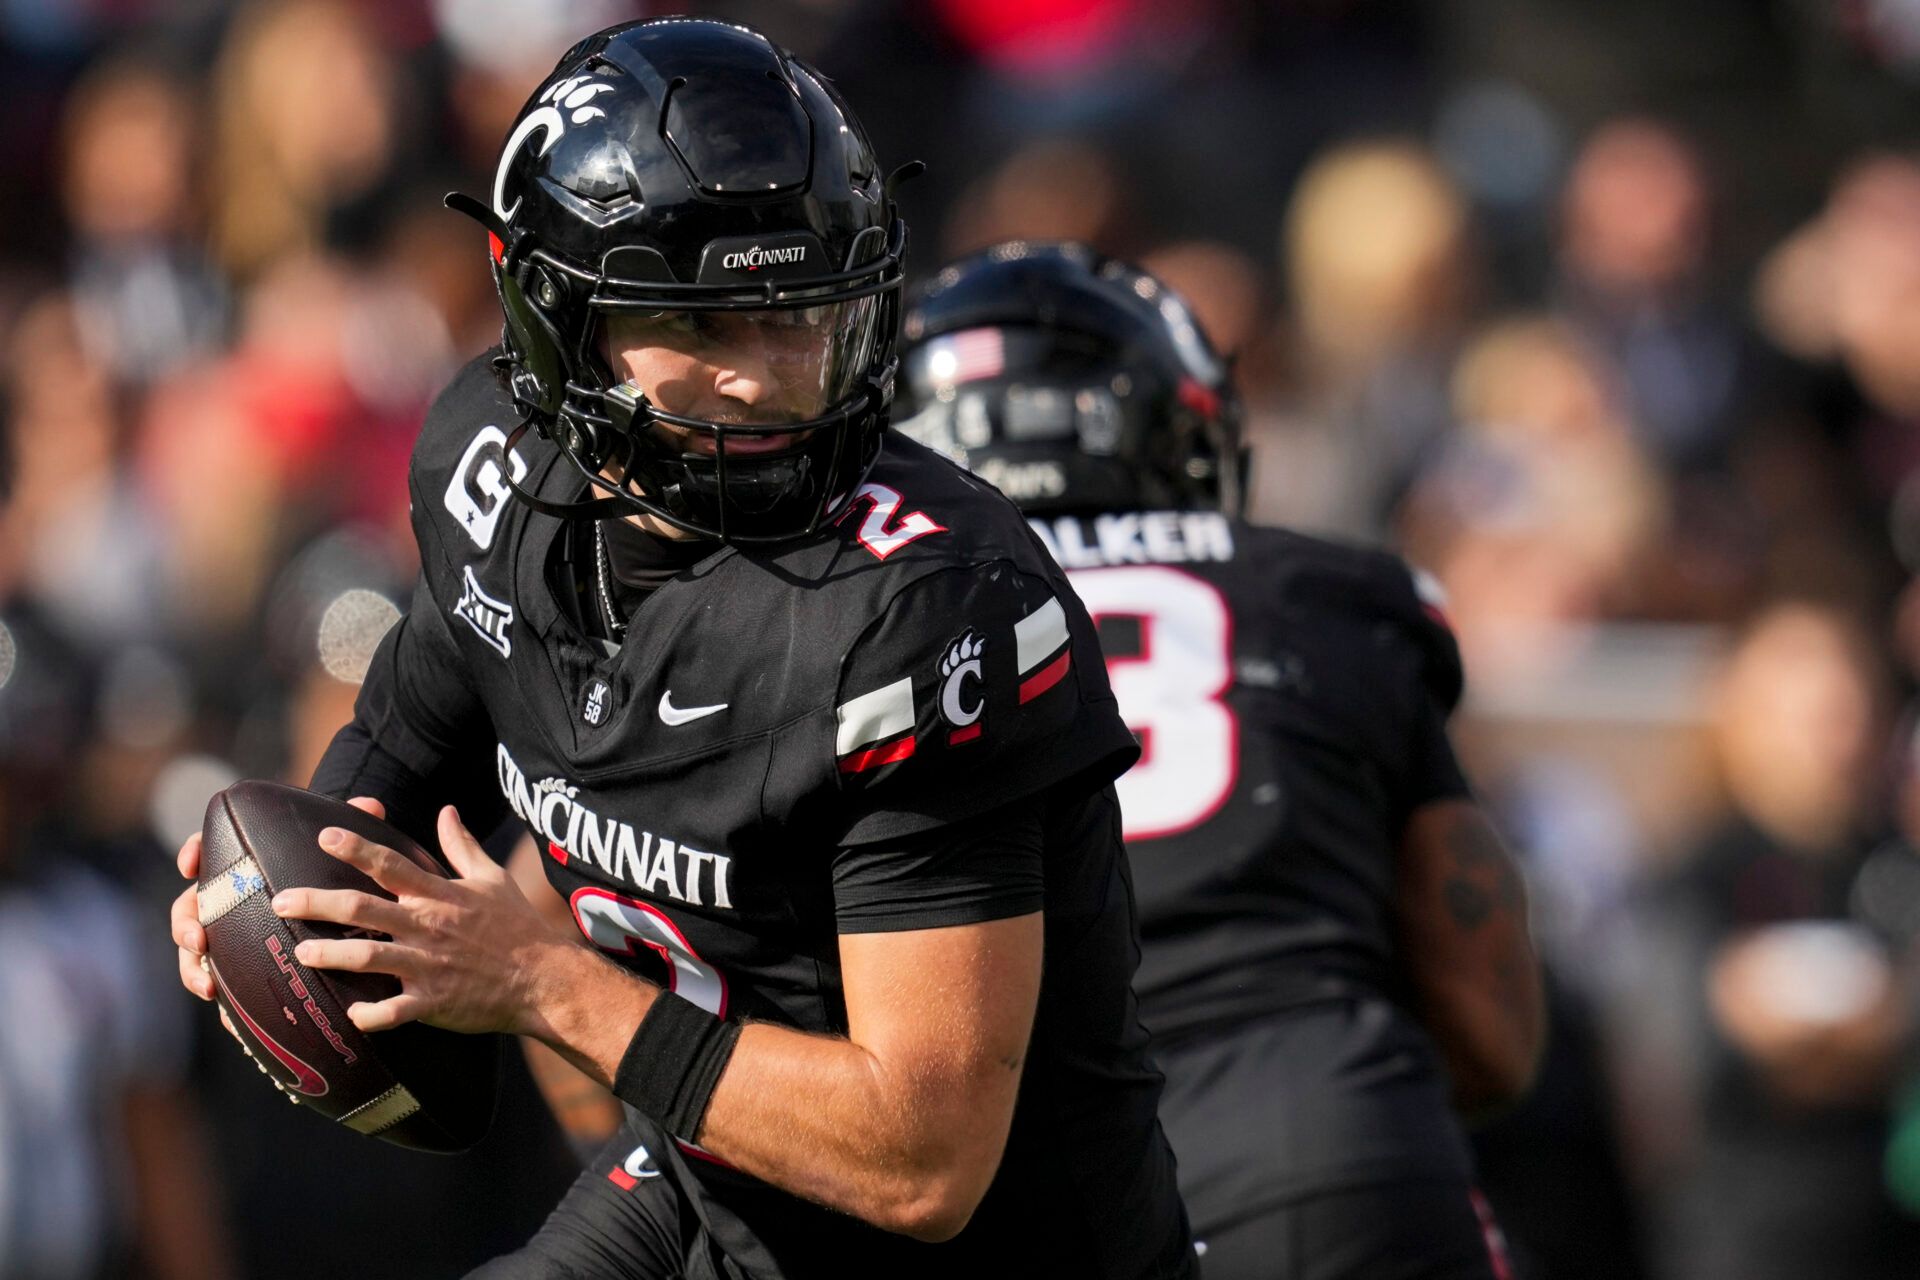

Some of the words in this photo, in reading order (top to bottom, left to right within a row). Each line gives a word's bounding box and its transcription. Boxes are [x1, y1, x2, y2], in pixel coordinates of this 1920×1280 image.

[723, 246, 806, 270] CINCINNATI
[824, 483, 950, 560] 2
[1026, 511, 1235, 568] ALKER
[583, 700, 602, 725] 58
[588, 682, 608, 706] JK
[1064, 562, 1241, 844] 3
[497, 742, 734, 909] CINCINNATI
[264, 933, 310, 1000] ELITE
[303, 994, 358, 1064] VAPOR
